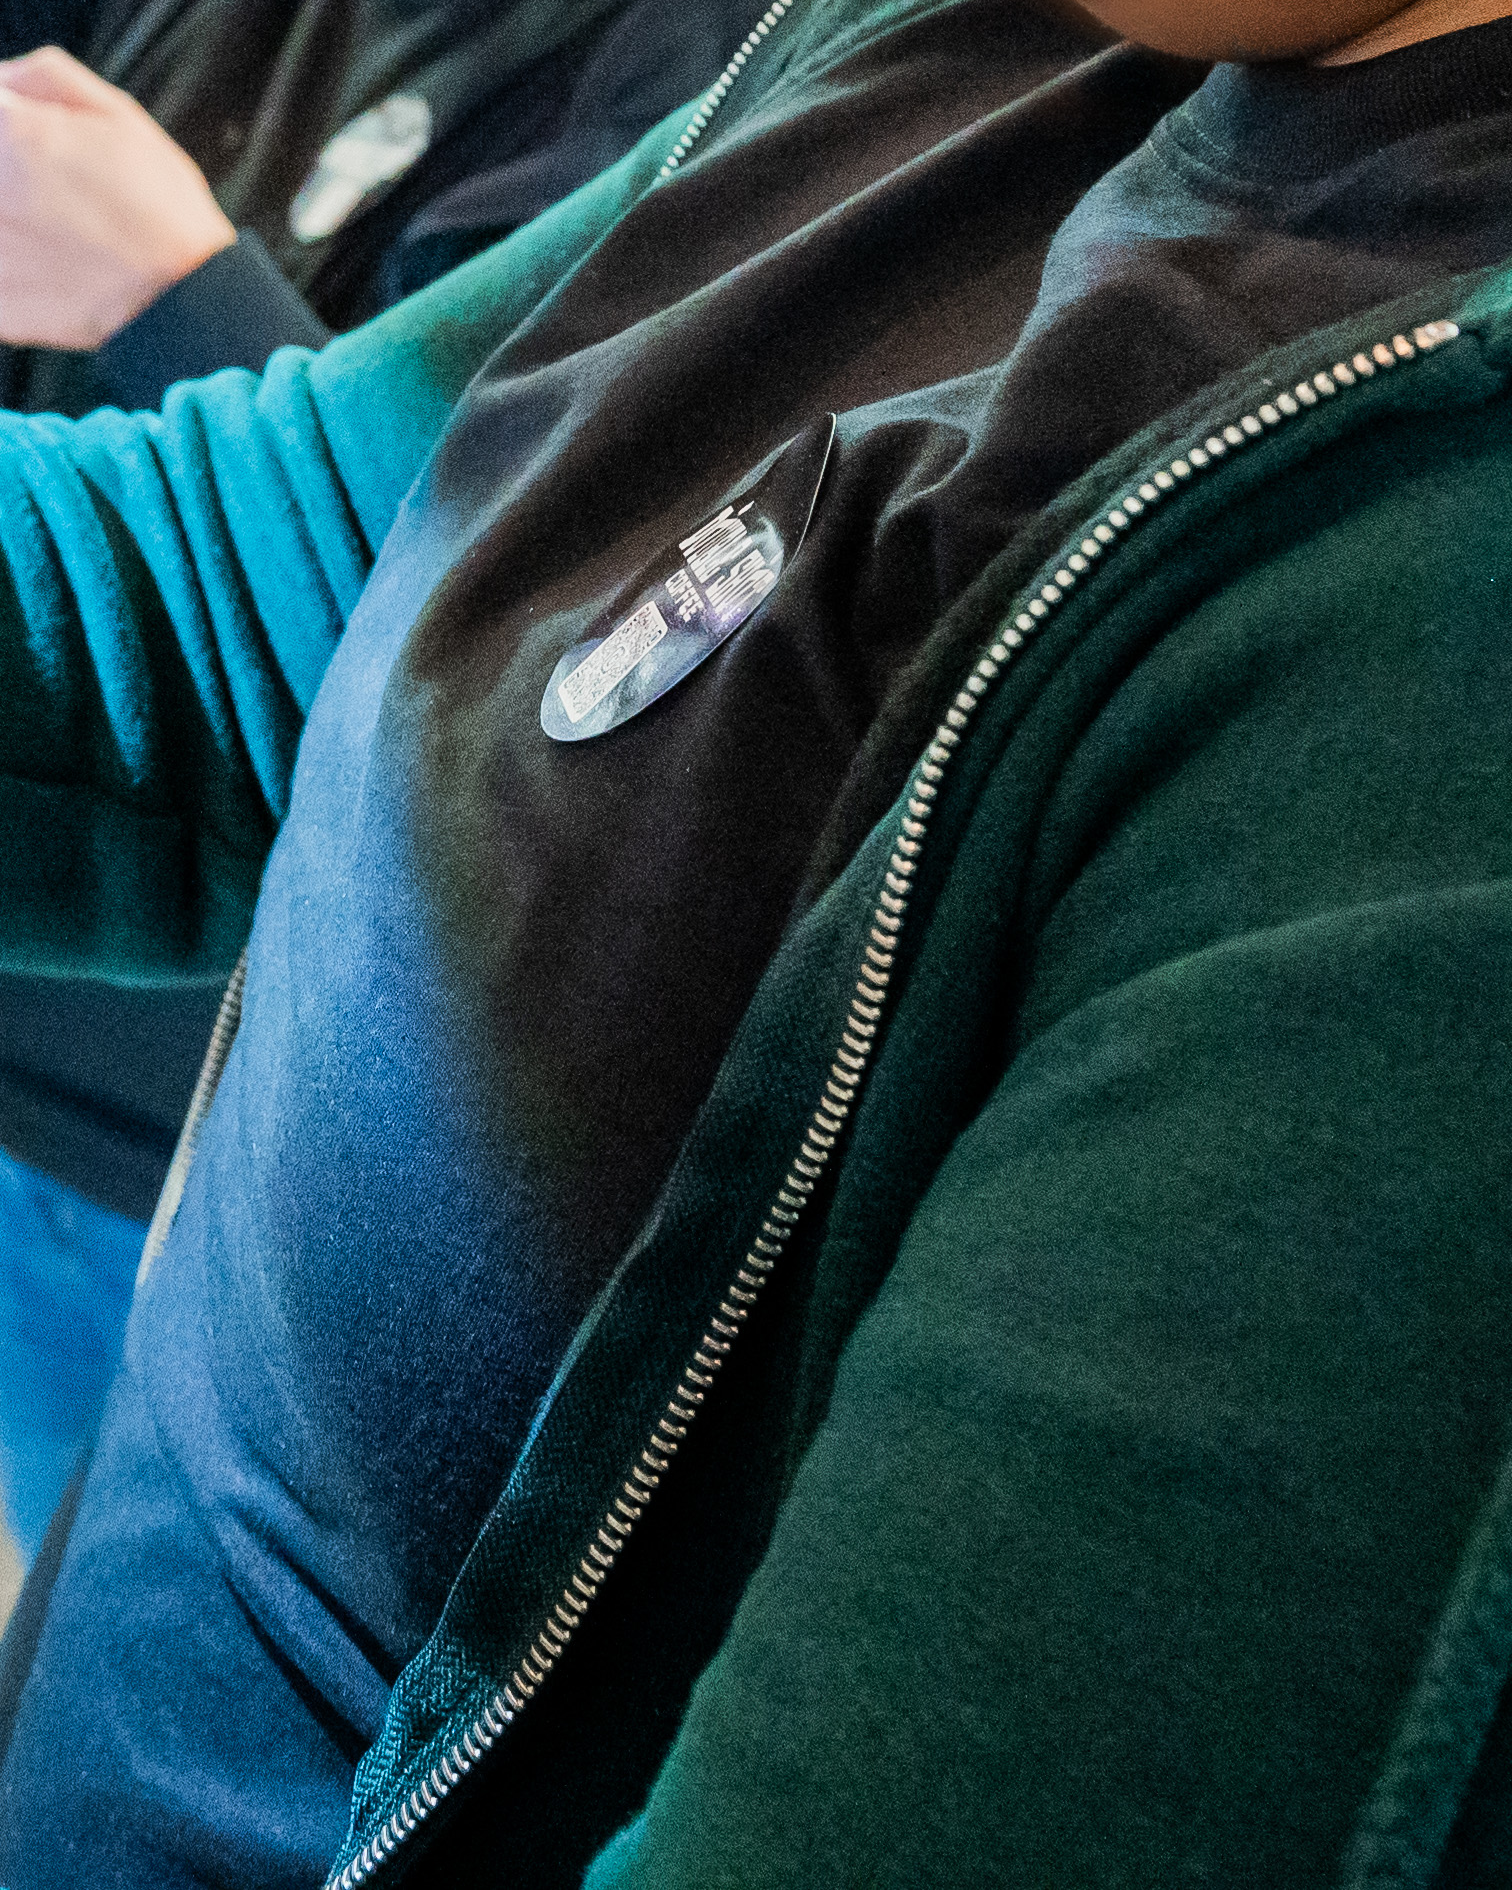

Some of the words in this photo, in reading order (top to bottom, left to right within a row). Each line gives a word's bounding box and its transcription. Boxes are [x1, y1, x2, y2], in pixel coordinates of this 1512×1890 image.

[679, 506, 754, 584] DOUBLE
[665, 569, 704, 623] COFFEE
[705, 549, 775, 623] SHOT
